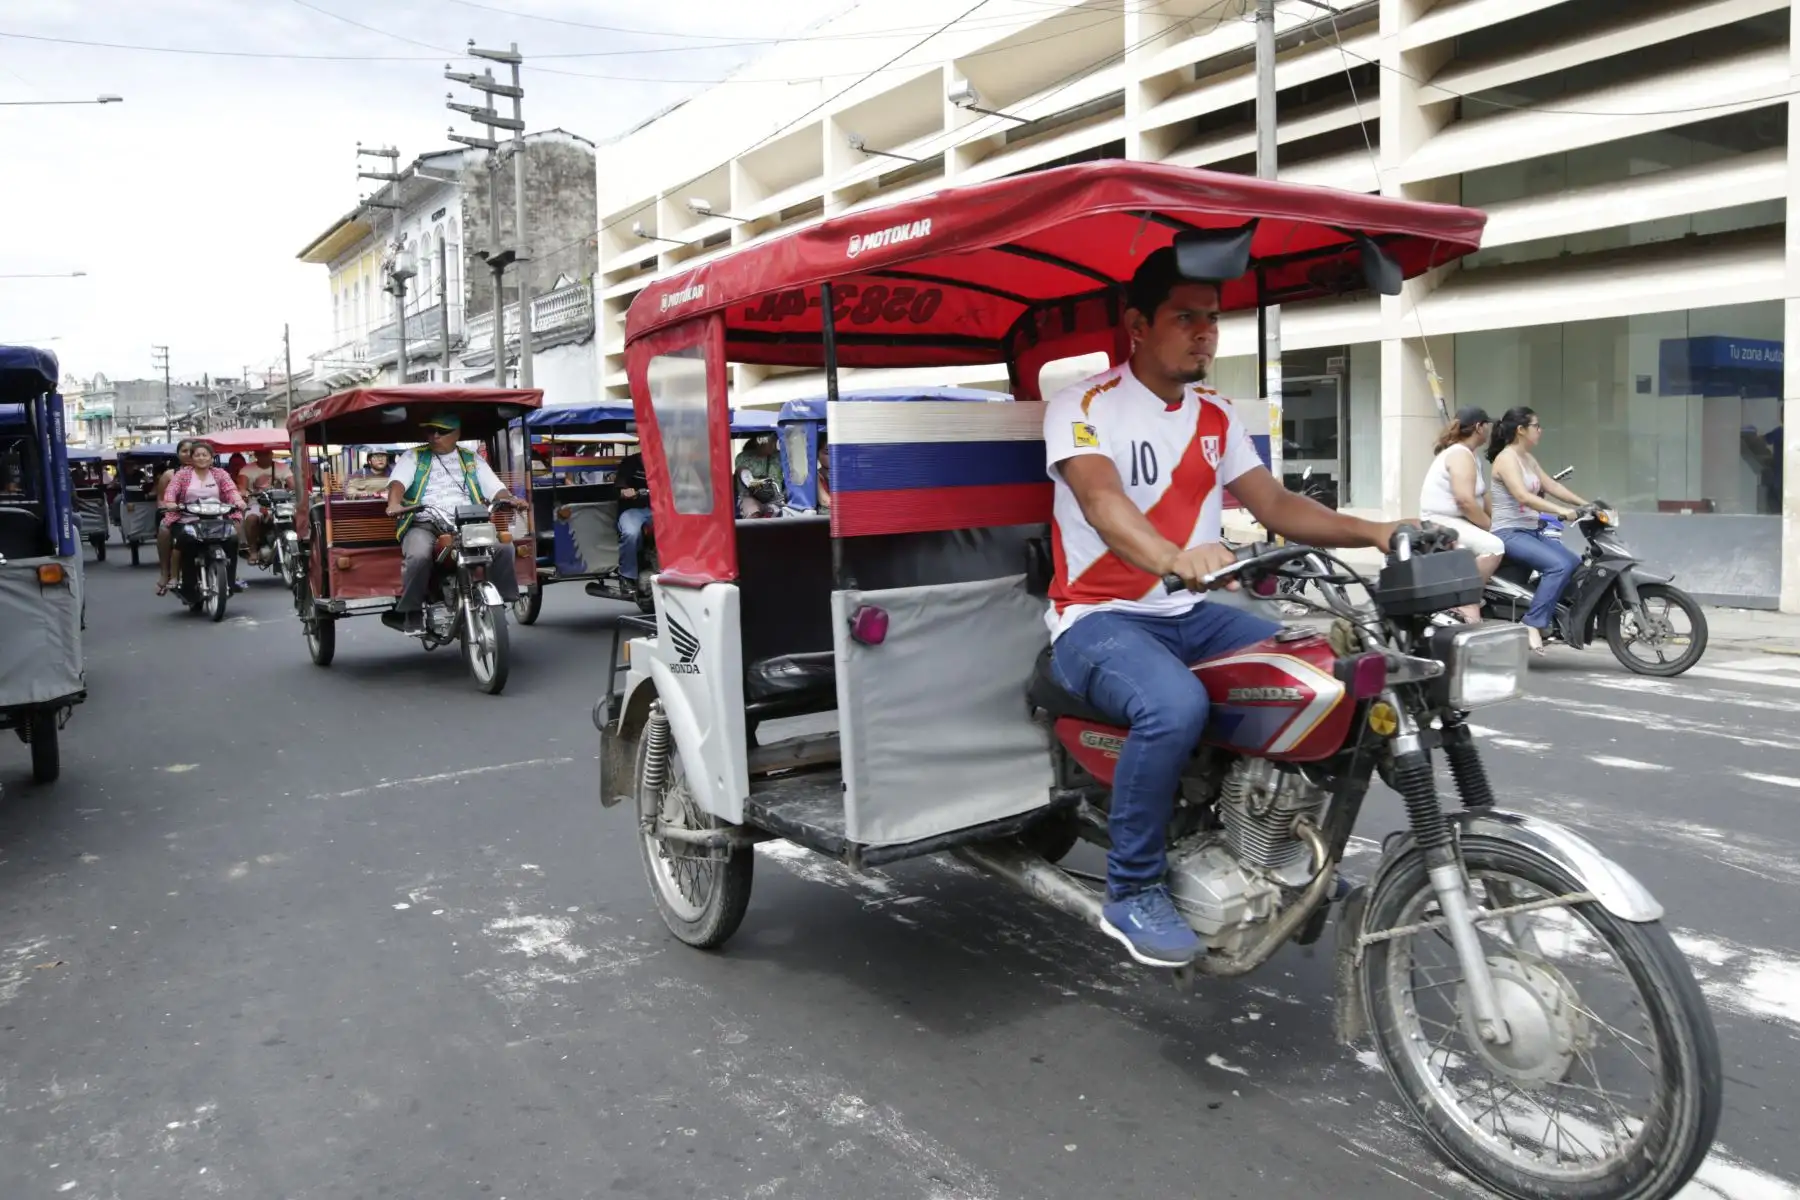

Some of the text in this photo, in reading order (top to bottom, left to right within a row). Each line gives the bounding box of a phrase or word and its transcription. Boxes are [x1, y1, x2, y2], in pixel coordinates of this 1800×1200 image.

[861, 218, 932, 252] MOTOKAR
[668, 284, 705, 307] MOTOKAR
[1729, 344, 1740, 359] Tu
[1742, 348, 1762, 361] zona
[1131, 440, 1158, 486] 10
[669, 663, 701, 674] HONDA
[1227, 687, 1304, 701] HONDA
